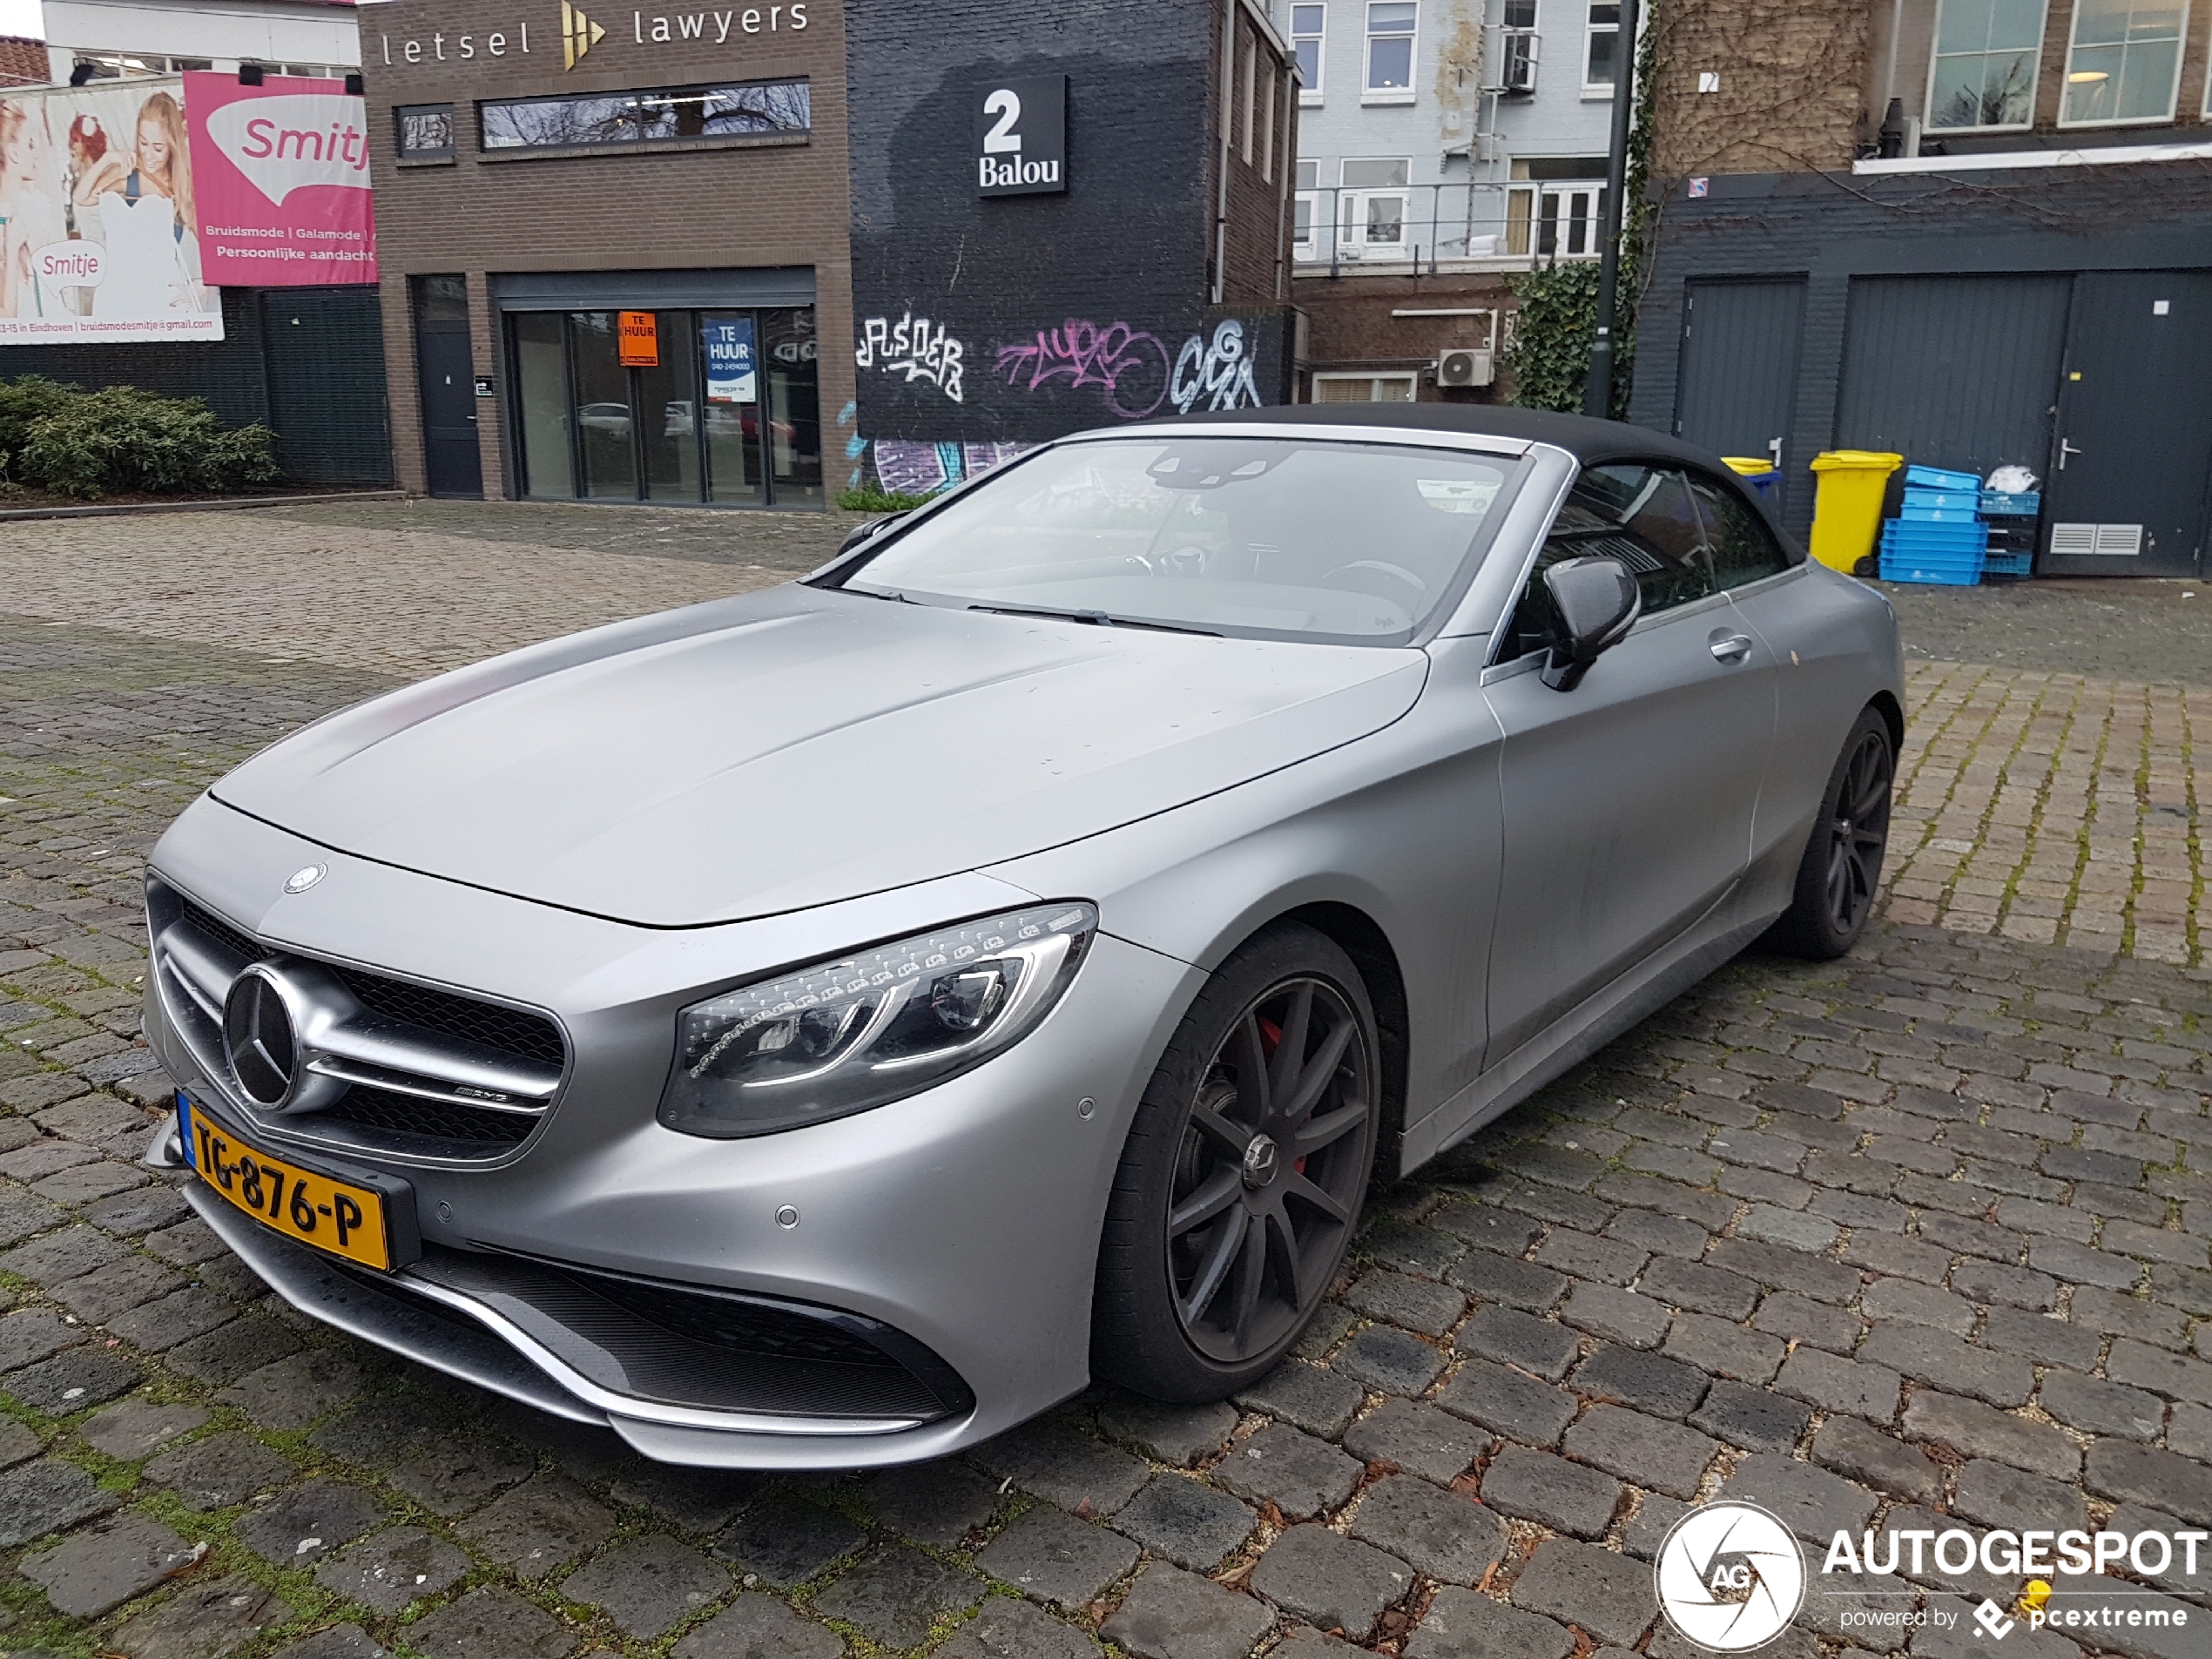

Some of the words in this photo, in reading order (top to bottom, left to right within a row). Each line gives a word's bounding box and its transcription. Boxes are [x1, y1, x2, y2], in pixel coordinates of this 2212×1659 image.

[381, 22, 531, 66] letsel
[633, 2, 810, 45] lawyers
[983, 89, 1022, 154] 2
[979, 154, 1060, 187] Balou
[206, 226, 285, 239] Bruidsmode
[295, 228, 361, 240] Galamode
[217, 246, 306, 261] Persoonlijke
[309, 249, 375, 261] aandacht
[43, 253, 99, 277] Smitje
[19, 323, 27, 332] in
[29, 322, 73, 333] Eindhoven
[631, 315, 645, 325] TE
[624, 326, 655, 337] HUUR
[718, 326, 736, 342] TE
[710, 343, 749, 360] HUUR
[194, 1120, 363, 1247] TG-876-P
